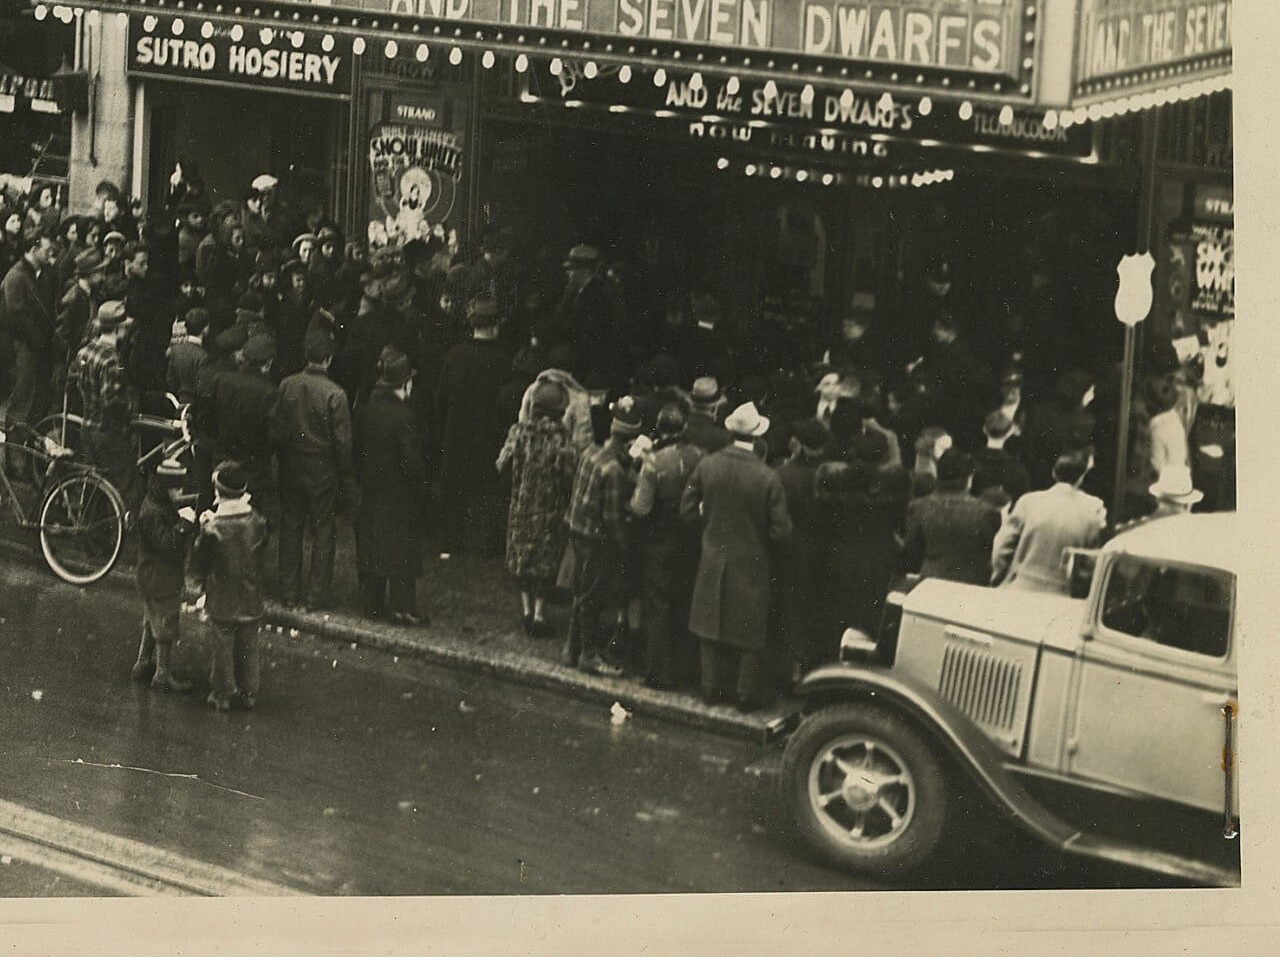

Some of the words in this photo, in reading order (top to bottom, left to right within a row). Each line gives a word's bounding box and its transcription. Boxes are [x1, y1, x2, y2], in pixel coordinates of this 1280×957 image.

[136, 36, 216, 71] SUTRO
[228, 45, 342, 85] HOSIERY
[805, 3, 1002, 72] DWARFS
[1143, 10, 1176, 64] THE
[396, 104, 436, 121] STRAND
[666, 80, 708, 108] AND
[751, 88, 813, 120] SEVEN
[824, 95, 913, 130] DWARFS
[371, 137, 418, 158] SNOW
[1205, 199, 1233, 214] STR
